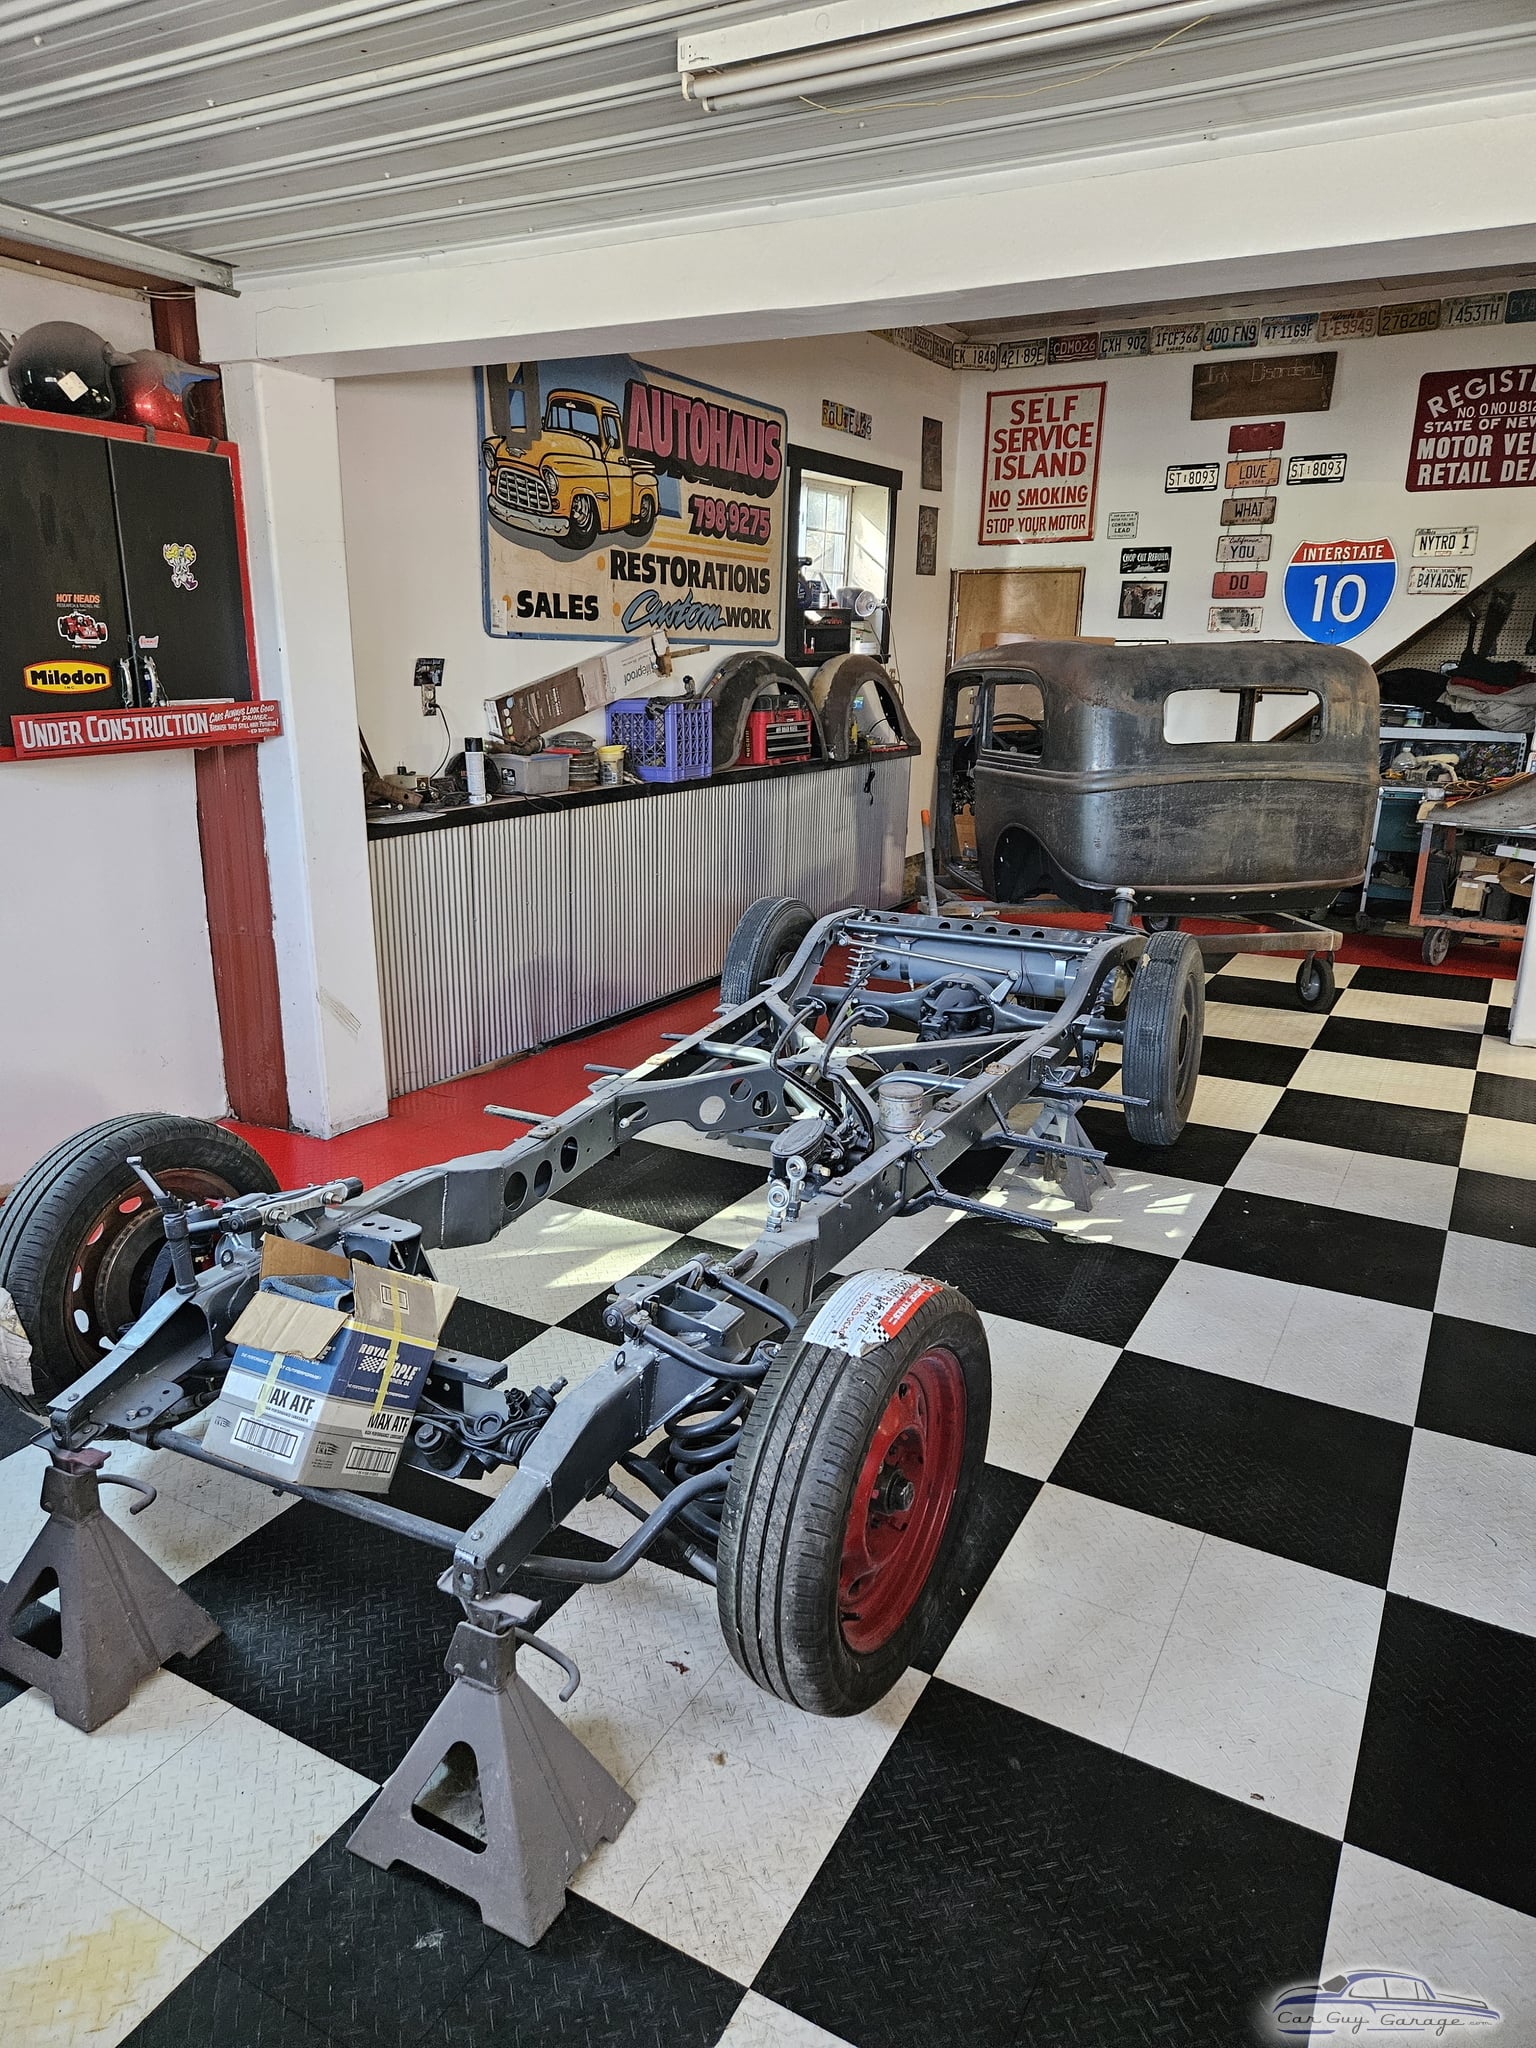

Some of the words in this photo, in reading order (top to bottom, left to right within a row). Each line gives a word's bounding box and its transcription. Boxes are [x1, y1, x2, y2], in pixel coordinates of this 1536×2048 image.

[1101, 337, 1122, 353] CXH
[1127, 335, 1148, 350] 902
[1156, 330, 1198, 347] 1FCF366
[1206, 327, 1230, 344] 400
[1232, 325, 1257, 342] FN9
[973, 349, 996, 364] 1848
[1427, 369, 1536, 419] REGIST
[1010, 395, 1079, 425] SELF
[624, 380, 783, 486] AUTOHAUS
[1424, 419, 1473, 433] STATE
[1478, 418, 1501, 431] OF
[992, 421, 1095, 453] SERVICE
[1416, 434, 1494, 460] MOTOR
[994, 450, 1087, 481] ISLAND
[1239, 464, 1267, 480] LOVE
[1417, 461, 1492, 486] RETAIL
[988, 489, 1011, 508] NO
[1017, 485, 1088, 507] SMOKING
[1235, 502, 1264, 518] WHAT
[986, 517, 1014, 534] STOP
[1018, 516, 1046, 532] YOUR
[1049, 514, 1087, 531] MOTOR
[1231, 546, 1255, 559] YOU
[1419, 535, 1456, 550] NYTRO
[1462, 534, 1470, 549] 1
[1303, 545, 1385, 561] INTERSTATE
[610, 549, 771, 595] RESTORATIONS
[1229, 575, 1249, 590] DO
[56, 594, 73, 603] HOT
[73, 594, 100, 604] HEADS
[516, 590, 600, 621] SALES
[1312, 574, 1367, 623] 10
[621, 588, 728, 633] Custom
[724, 606, 772, 630] WORK
[30, 670, 107, 685] Milodon
[209, 712, 224, 723] CARS
[246, 706, 260, 714] LOOK
[260, 704, 275, 713] GOOD
[19, 720, 85, 749] UNDER
[85, 711, 210, 743] CONSTRUCTION
[376, 1360, 417, 1381] PRPLE
[289, 1394, 315, 1415] ATF
[367, 1412, 393, 1431] MAX
[391, 1415, 410, 1433] ATF
